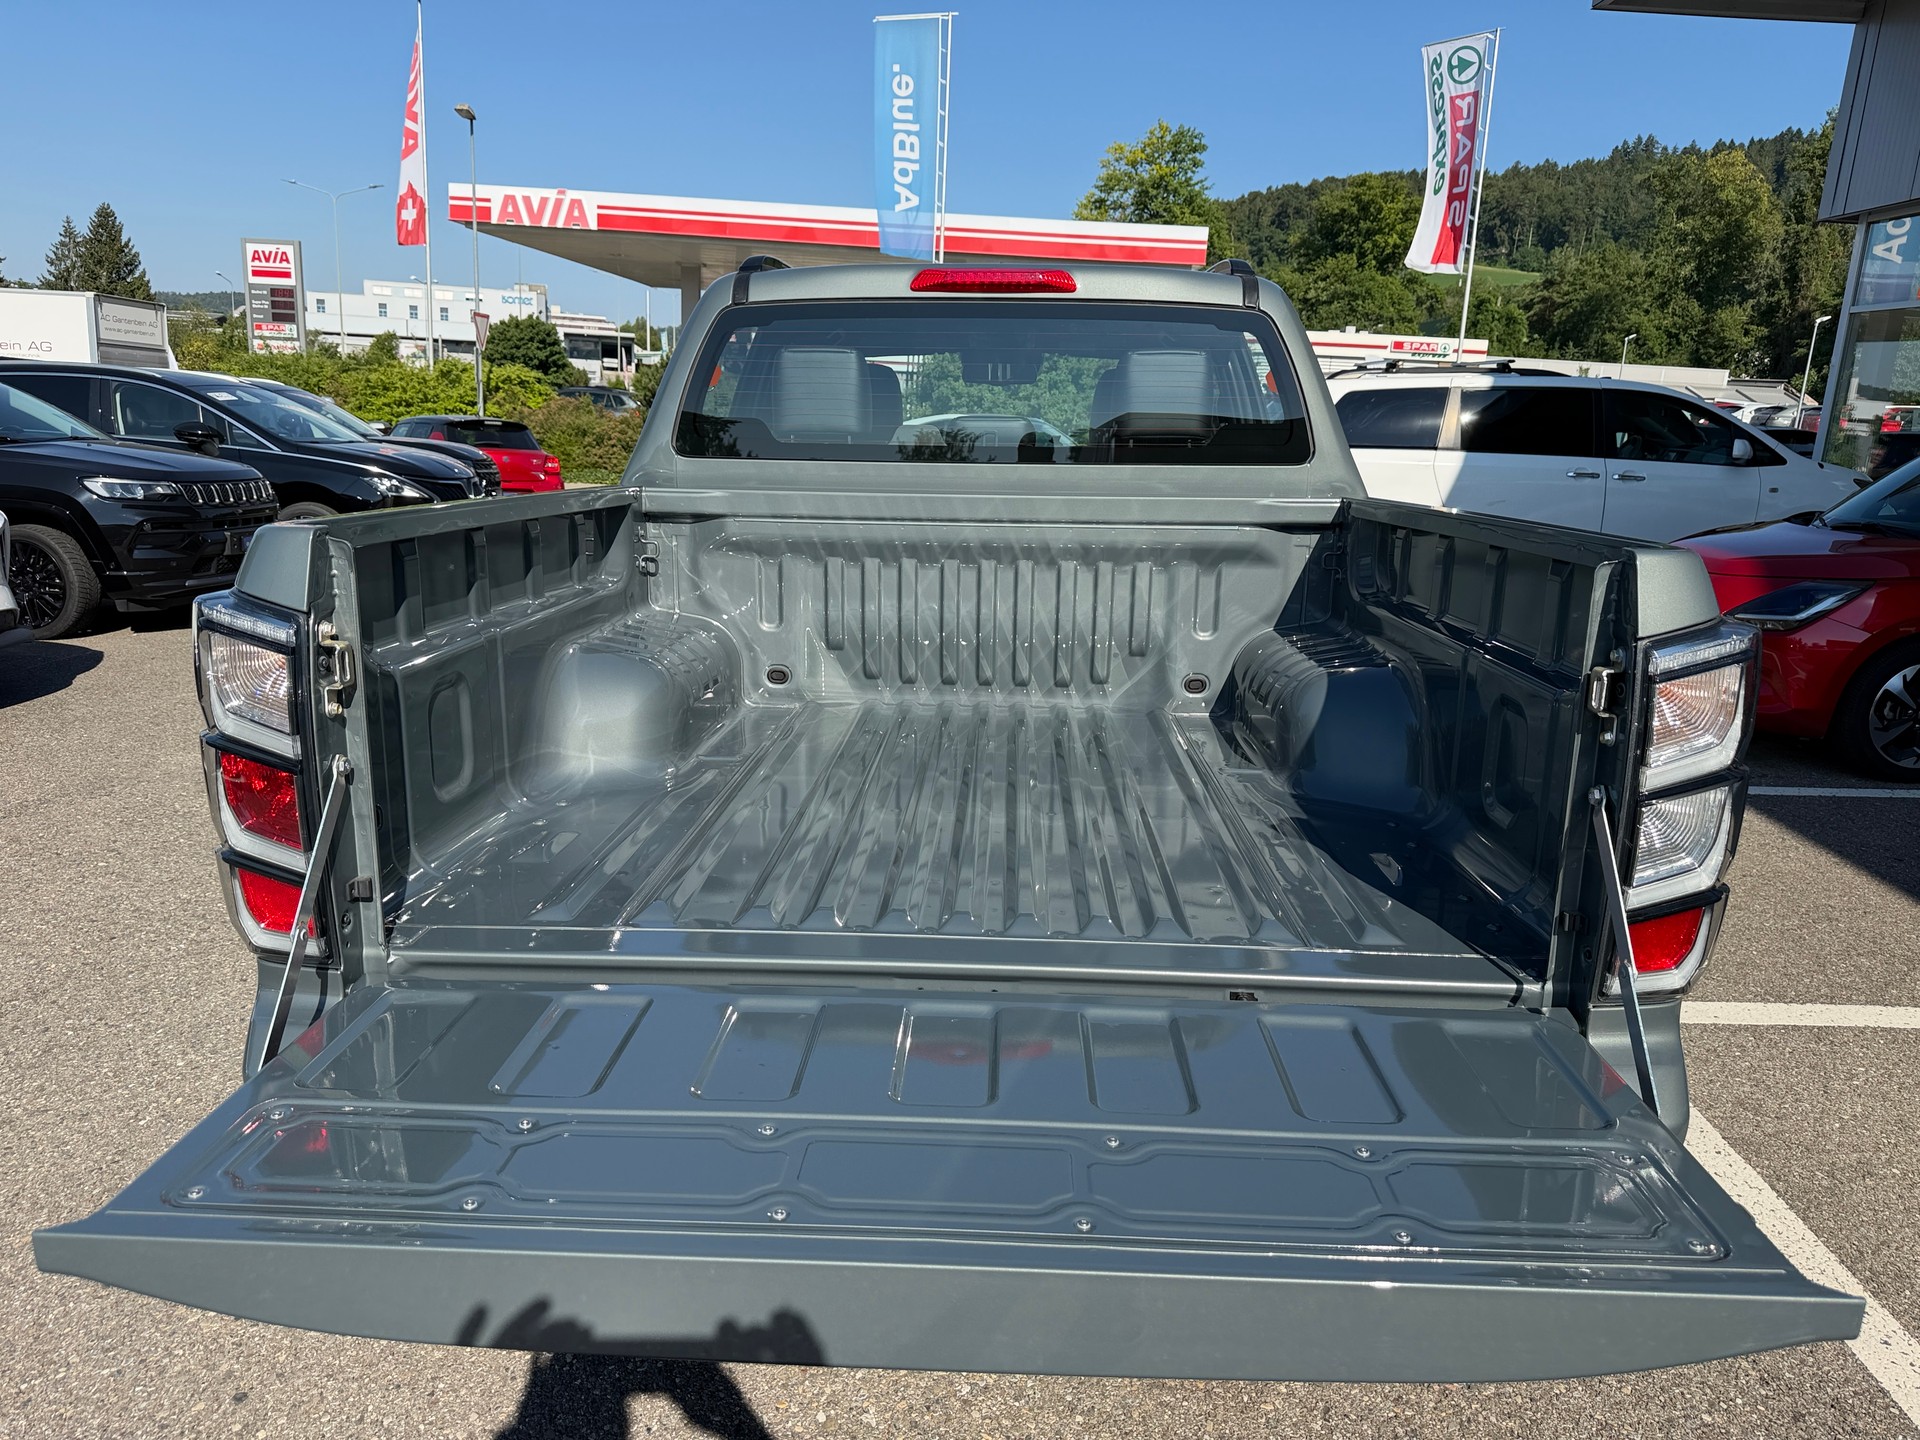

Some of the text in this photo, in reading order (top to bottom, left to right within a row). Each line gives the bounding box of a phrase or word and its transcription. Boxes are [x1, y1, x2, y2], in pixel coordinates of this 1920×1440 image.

[497, 189, 590, 229] AVIA
[251, 247, 291, 264] AVIA
[28, 341, 53, 352] AG
[1403, 342, 1438, 352] SPAR
